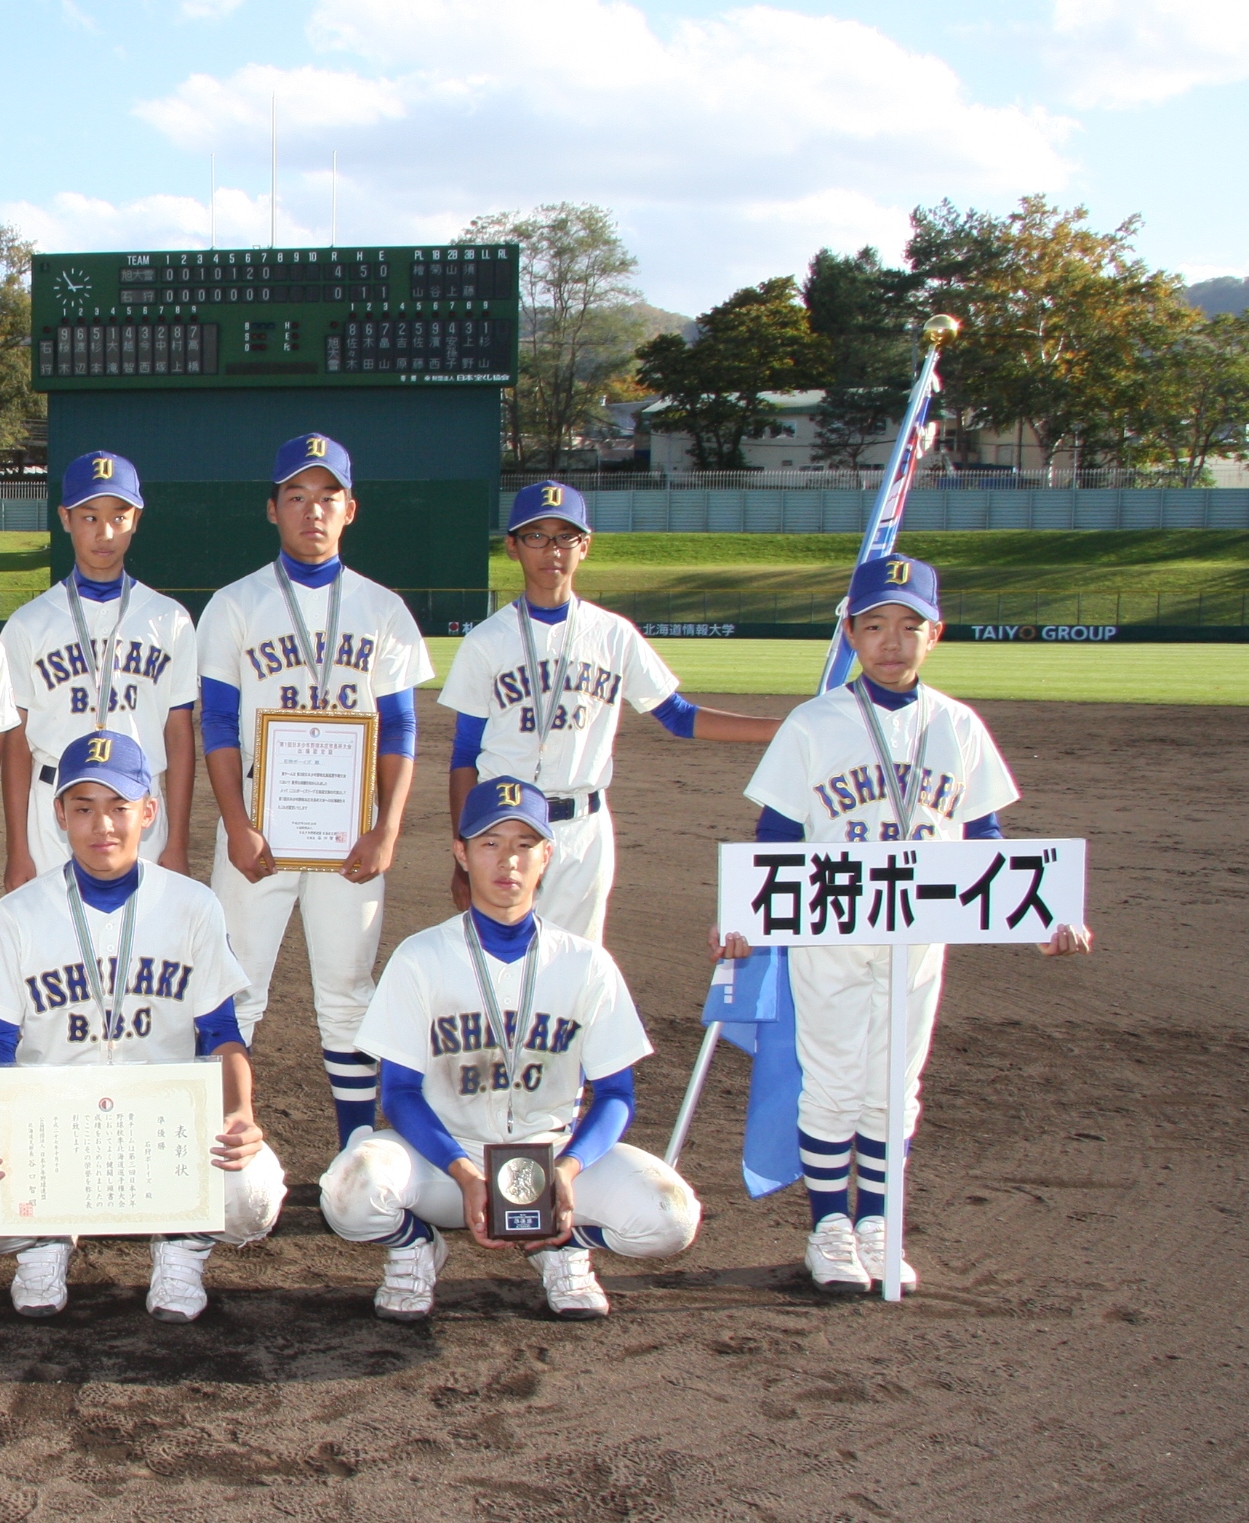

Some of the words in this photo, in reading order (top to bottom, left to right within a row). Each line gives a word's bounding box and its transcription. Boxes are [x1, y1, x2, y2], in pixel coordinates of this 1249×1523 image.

[127, 255, 149, 265] TEAM
[166, 255, 170, 265] 1
[181, 255, 187, 265] 2
[197, 254, 203, 264] 3
[213, 254, 219, 264] 4
[229, 253, 235, 263] 5
[245, 253, 251, 263] 6
[261, 253, 267, 263] 7
[277, 252, 283, 262] 8
[293, 252, 300, 262] 9
[309, 252, 317, 262] 10
[331, 251, 337, 261] R
[356, 251, 363, 261] H
[378, 250, 385, 261] E
[414, 250, 424, 260] PL
[432, 250, 440, 260] 1B
[447, 249, 458, 260] 2B
[464, 249, 475, 260] 3B
[481, 249, 490, 260] LL
[497, 249, 508, 259] RL
[166, 269, 173, 281] 0
[182, 268, 189, 281] 0
[200, 268, 204, 280] 1
[215, 268, 221, 280] 0
[233, 268, 236, 279] 1
[247, 267, 253, 279] 2
[263, 267, 269, 279] 0
[335, 265, 341, 277] 4
[360, 265, 367, 277] 5
[380, 265, 387, 277] 0
[166, 290, 173, 302] 0
[182, 290, 189, 302] 0
[198, 289, 205, 301] 0
[215, 289, 221, 301] 0
[231, 289, 237, 301] 0
[246, 289, 253, 301] 0
[262, 288, 269, 300] 0
[335, 287, 341, 299] 0
[362, 287, 366, 299] 1
[382, 286, 386, 299] 1
[63, 308, 66, 316] 1
[78, 308, 83, 316] 2
[94, 307, 100, 316] 3
[110, 307, 115, 315] 4
[126, 306, 131, 315] 5
[142, 306, 148, 315] 6
[159, 306, 164, 314] 7
[175, 305, 180, 314] 8
[191, 305, 196, 313] 9
[351, 303, 354, 311] 1
[366, 302, 371, 311] 2
[383, 302, 388, 310] 3
[399, 302, 405, 310] 4
[416, 302, 421, 310] 5
[433, 301, 438, 310] 6
[450, 301, 455, 310] 7
[466, 301, 471, 310] 8
[483, 301, 488, 309] 9
[284, 321, 290, 329] H
[350, 323, 356, 335] 8
[366, 323, 372, 335] 6
[382, 323, 389, 335] 7
[399, 323, 405, 335] 2
[415, 323, 422, 334] 5
[432, 322, 439, 334] 9
[449, 322, 455, 334] 4
[465, 322, 472, 334] 3
[484, 322, 488, 334] 1
[61, 329, 68, 340] 9
[77, 328, 84, 339] 6
[93, 328, 100, 339] 5
[111, 328, 115, 339] 1
[126, 327, 132, 338] 4
[142, 327, 148, 338] 3
[158, 327, 164, 338] 2
[174, 326, 181, 338] 8
[190, 326, 197, 337] 7
[244, 332, 249, 341] S
[285, 332, 290, 340] E
[643, 623, 735, 636] 北海道情報大学
[972, 625, 1036, 641] TAIYO
[1042, 625, 1117, 641] GROUP
[34, 639, 172, 692] ISHARI
[752, 847, 1058, 936] 石狩ボーイズ
[175, 1125, 189, 1177] 表彰状
